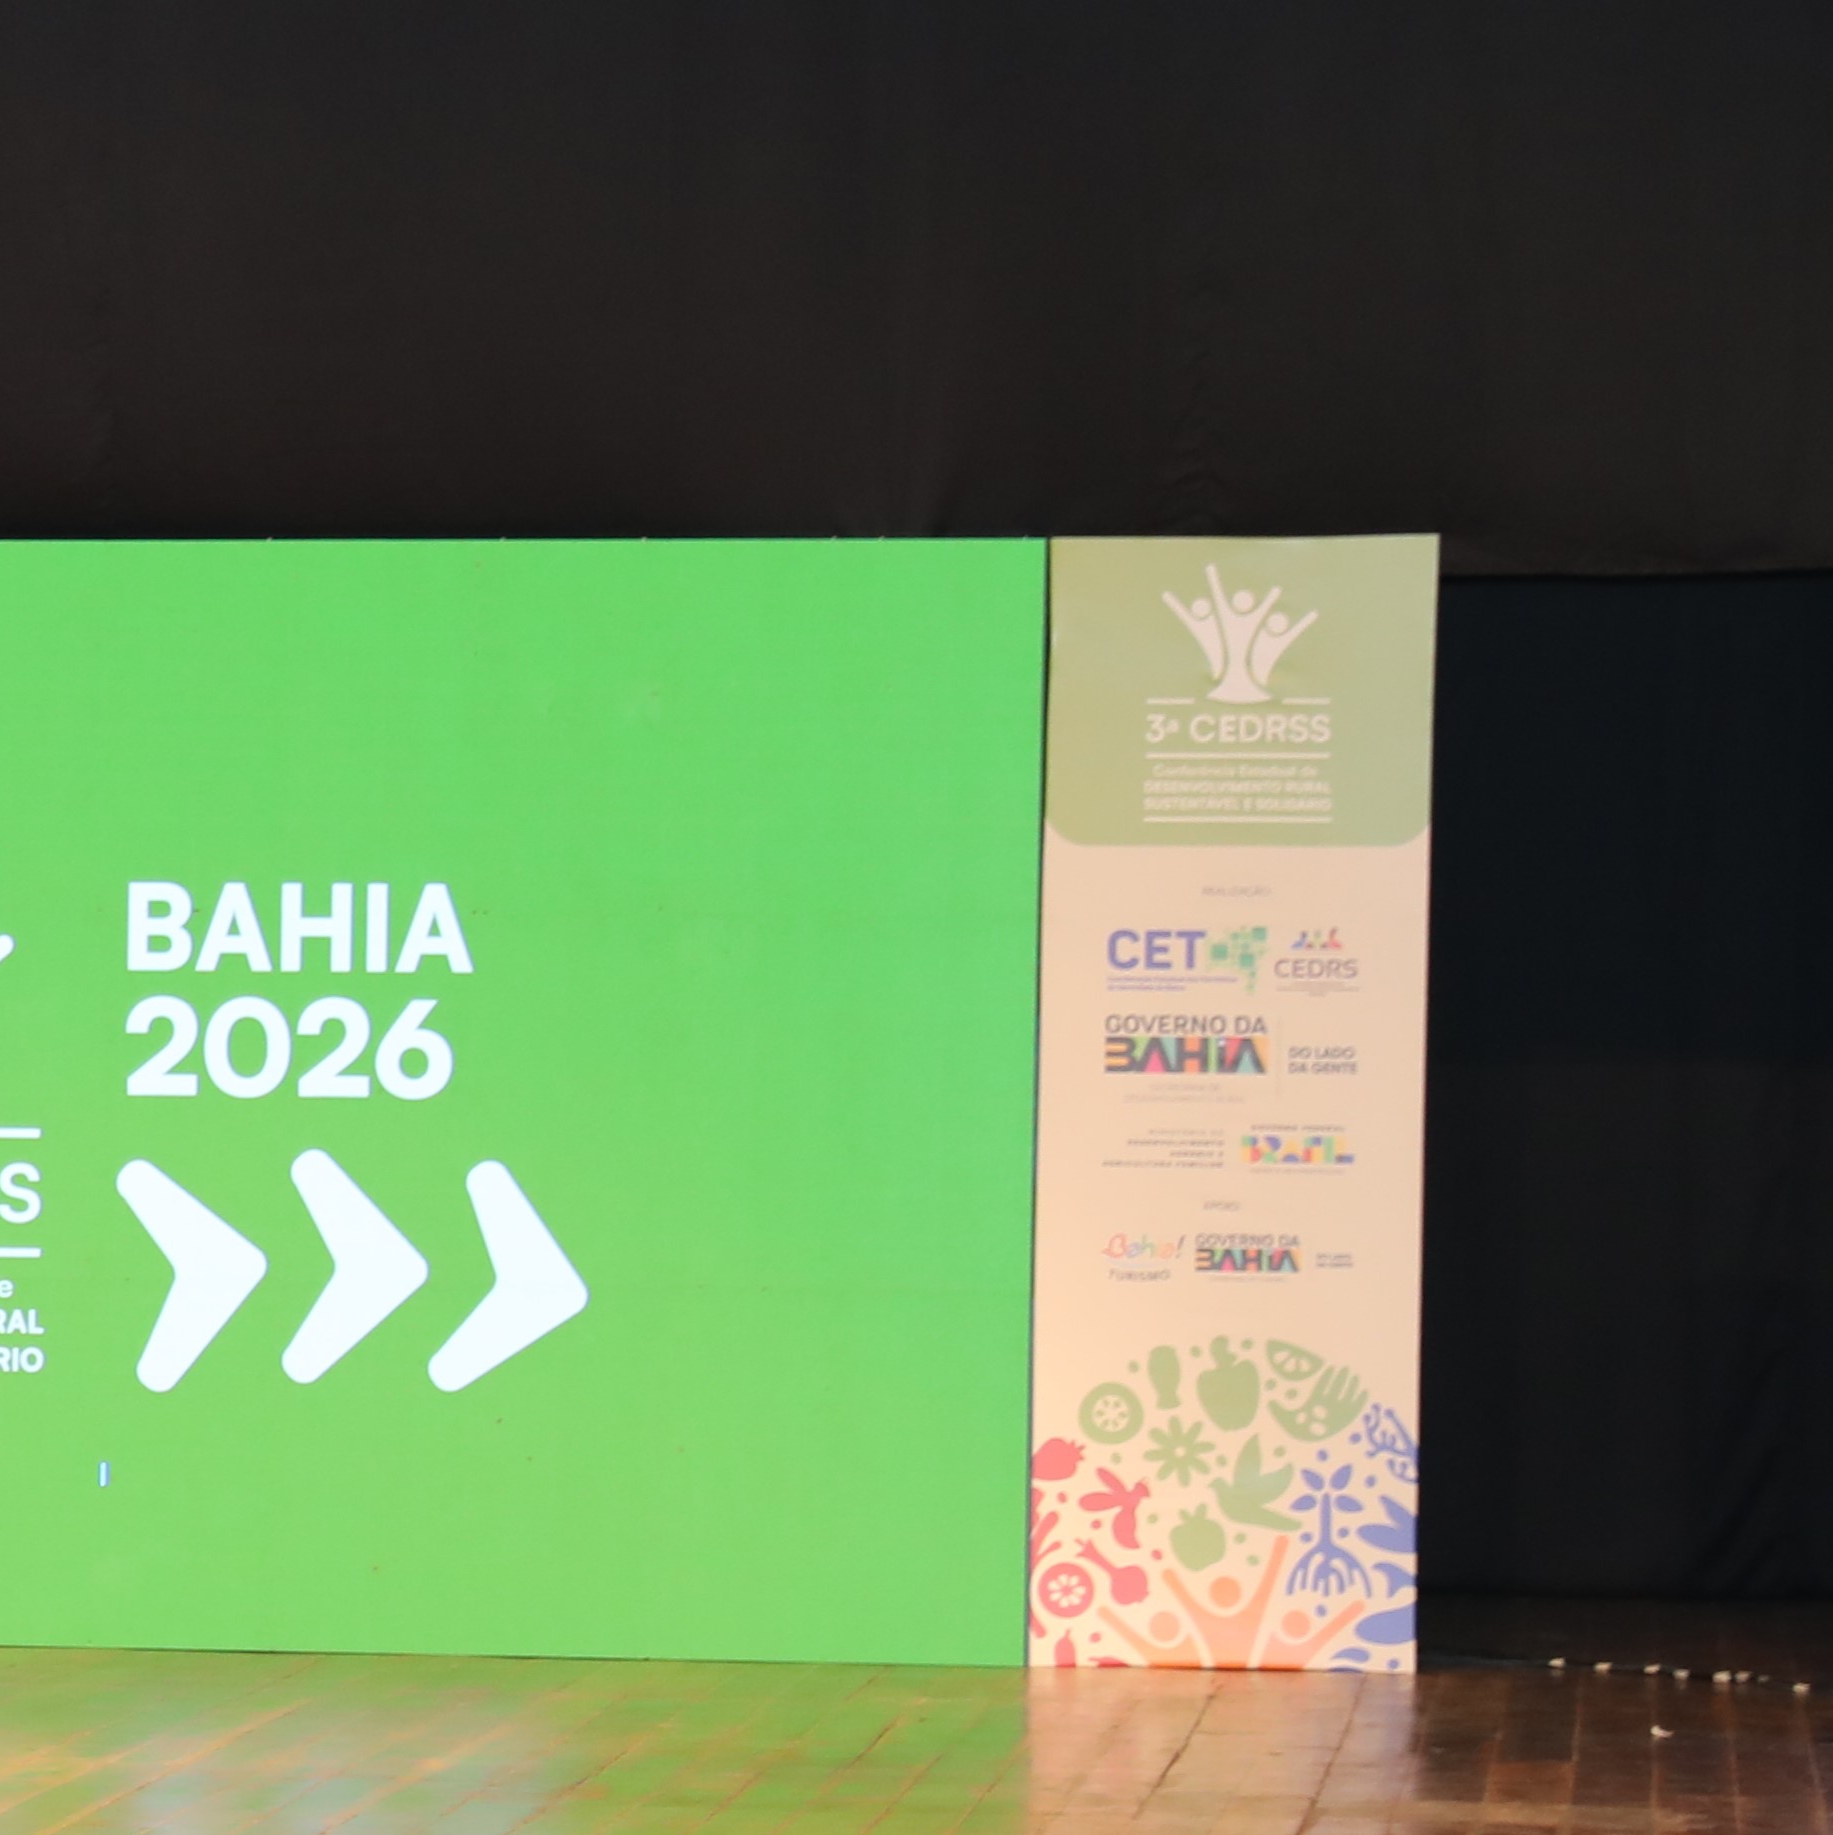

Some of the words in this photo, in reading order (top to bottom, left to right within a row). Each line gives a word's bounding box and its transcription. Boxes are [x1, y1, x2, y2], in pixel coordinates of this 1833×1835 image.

[1189, 714, 1331, 743] CEDRSS
[126, 881, 474, 974] BAHIA
[1107, 929, 1207, 970] CET
[1273, 958, 1359, 980] CEDRS
[1104, 1013, 1227, 1035] GOVERNO
[1235, 1014, 1268, 1036] DA
[125, 995, 453, 1101] 2026
[1104, 1035, 1269, 1074] BAHIA
[1194, 1248, 1303, 1273] BAHIA
